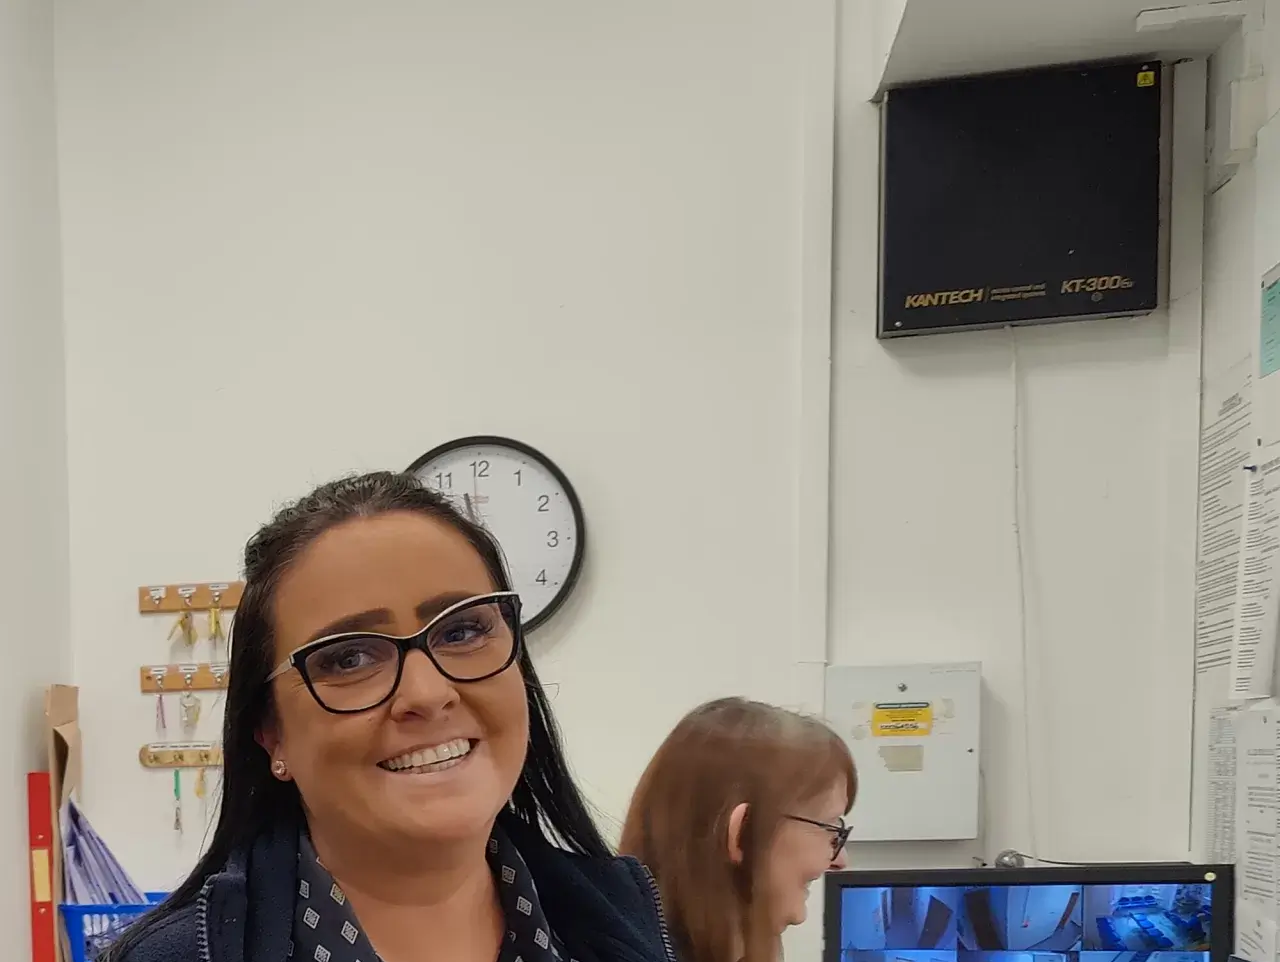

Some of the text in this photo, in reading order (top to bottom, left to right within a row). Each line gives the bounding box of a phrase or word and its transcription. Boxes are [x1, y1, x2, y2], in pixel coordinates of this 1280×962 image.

[905, 289, 983, 308] KANTECH
[469, 460, 490, 478] 12
[514, 469, 521, 486] 1
[435, 472, 452, 488] 11
[537, 494, 550, 512] 2
[547, 530, 559, 548] 3
[535, 568, 548, 586] 4
